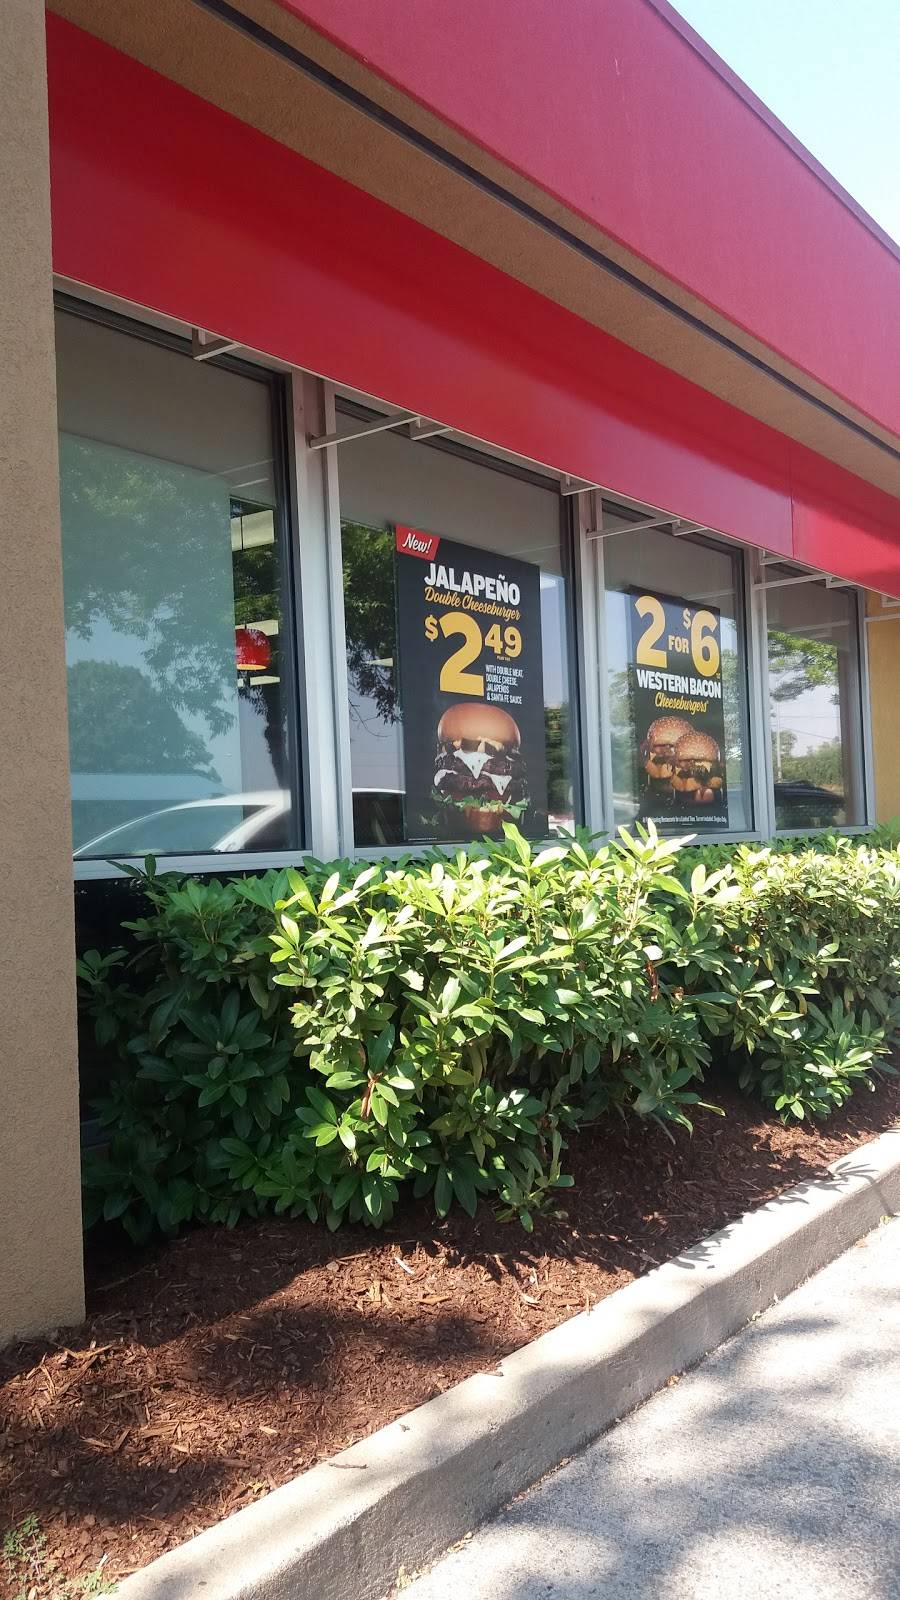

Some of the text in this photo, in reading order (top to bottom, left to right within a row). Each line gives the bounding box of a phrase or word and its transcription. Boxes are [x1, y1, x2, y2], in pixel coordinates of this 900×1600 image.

[402, 533, 432, 554] New!
[424, 563, 521, 606] JALAPEÑO
[424, 587, 521, 622] Double Cheeseburger
[634, 595, 668, 669] 2
[668, 635, 690, 654] FOR
[485, 664, 496, 674] WITH
[497, 665, 512, 676] DOUBLE
[485, 673, 502, 684] DOUBLE
[636, 668, 722, 699] WESTERN BACON
[490, 692, 504, 702] SANTA
[504, 694, 510, 703] FE
[509, 694, 522, 705] SAUCE
